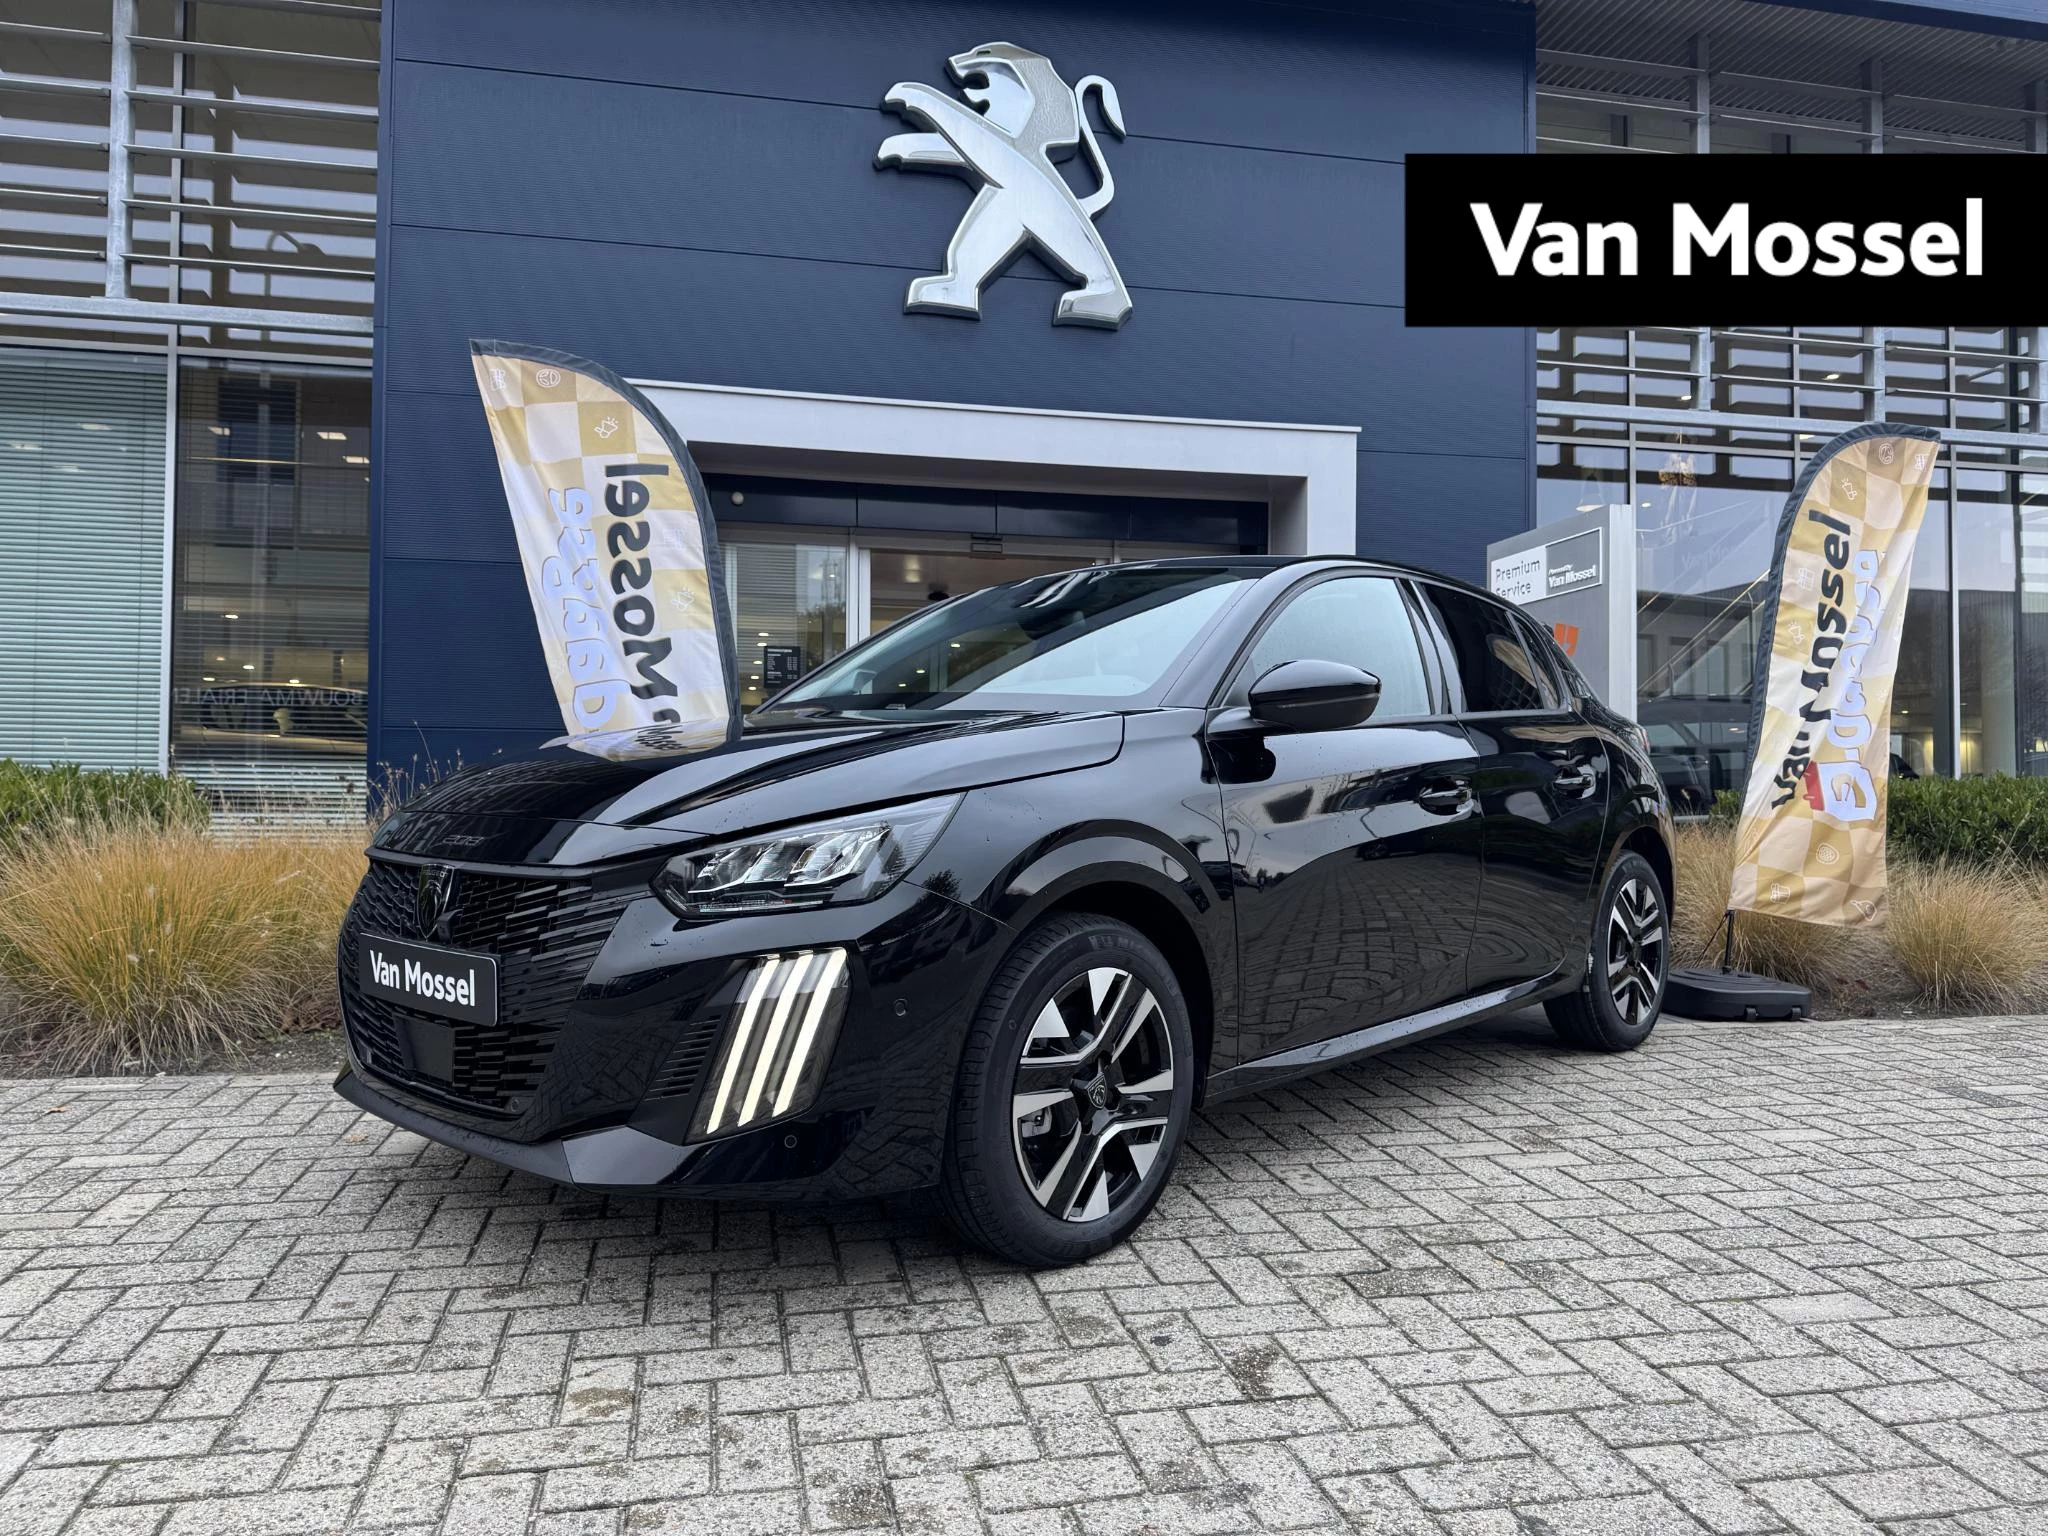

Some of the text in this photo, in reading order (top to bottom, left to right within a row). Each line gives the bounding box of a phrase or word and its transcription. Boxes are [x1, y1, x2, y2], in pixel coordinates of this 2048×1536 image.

[1495, 560, 1540, 582] Premium
[1548, 564, 1597, 588] Van Mossel
[1495, 581, 1531, 598] Service
[370, 949, 476, 1007] Van Mossel
